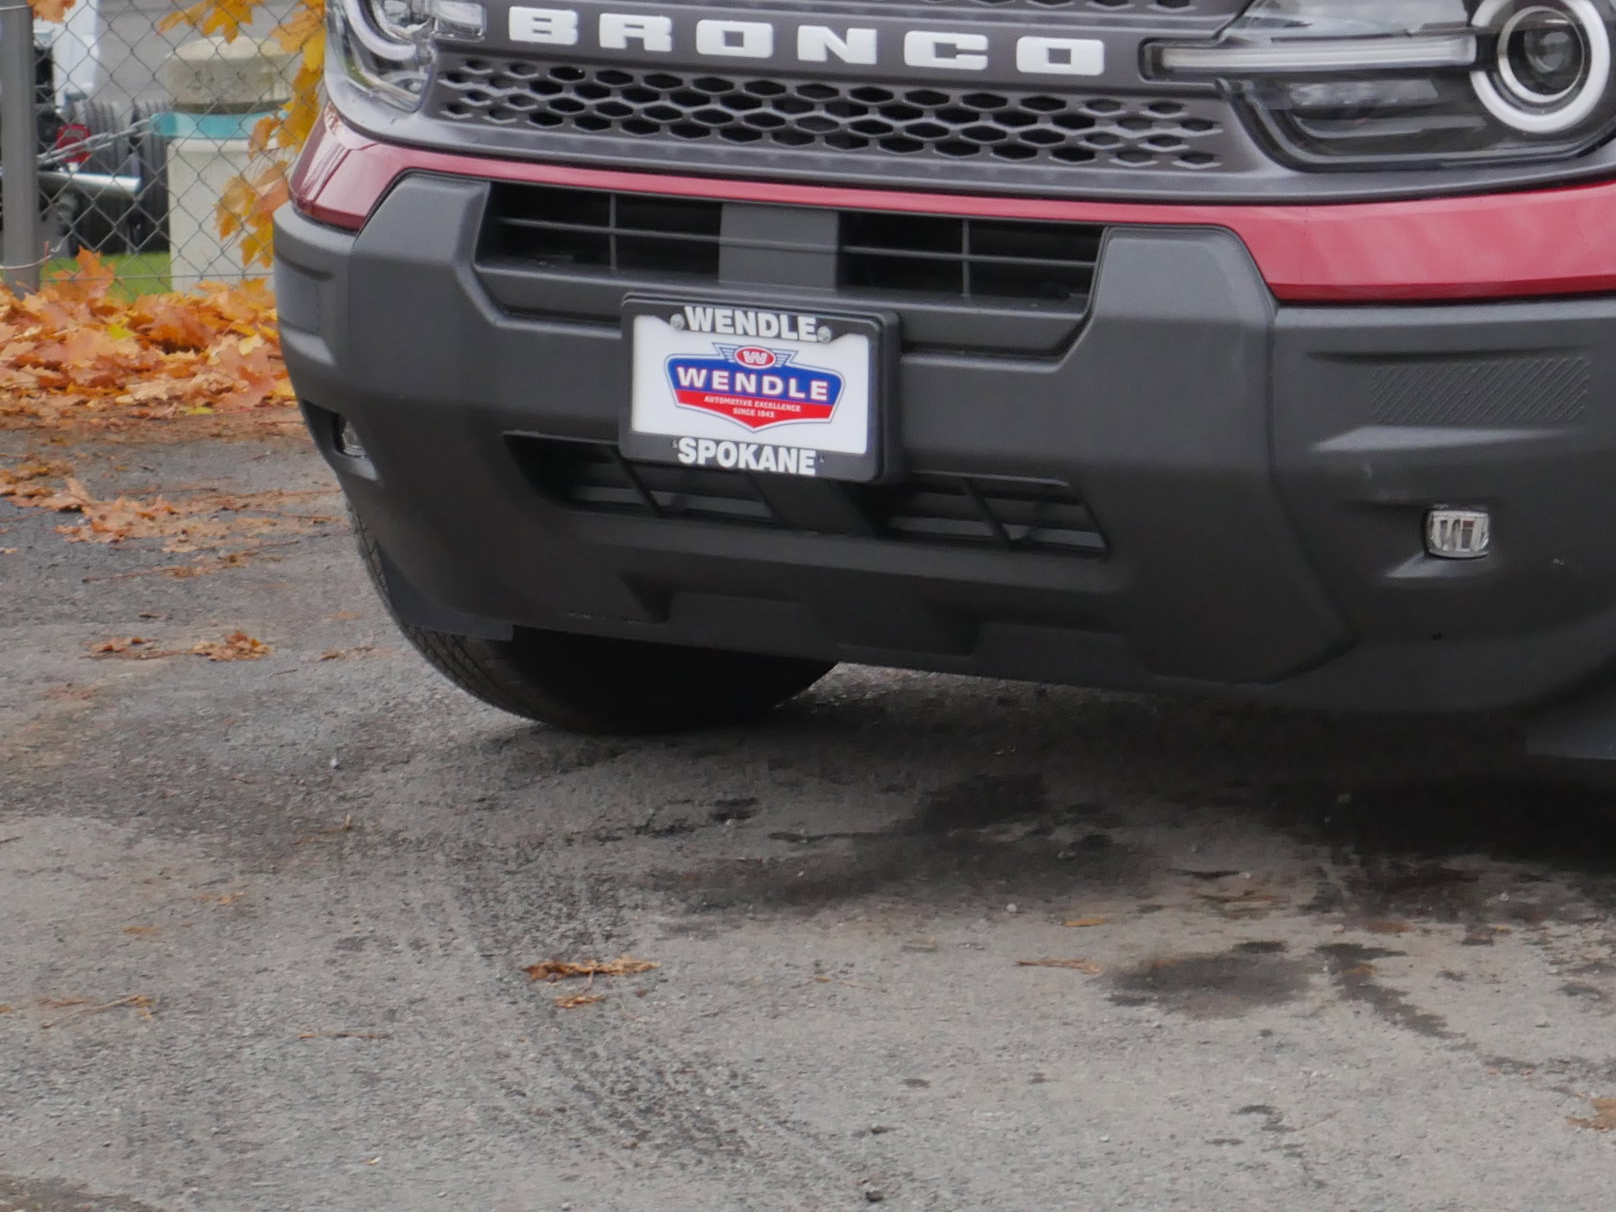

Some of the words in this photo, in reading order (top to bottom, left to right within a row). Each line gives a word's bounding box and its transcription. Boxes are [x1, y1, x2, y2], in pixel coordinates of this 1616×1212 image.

[508, 5, 1104, 77] BRONCO
[684, 306, 817, 342] WENDLE
[677, 366, 828, 401] WENDLE
[704, 395, 753, 407] AUTOMOTIVE
[754, 401, 801, 412] EXCELLENCE
[733, 407, 755, 416] SINCE
[678, 437, 816, 475] SPOKANE
